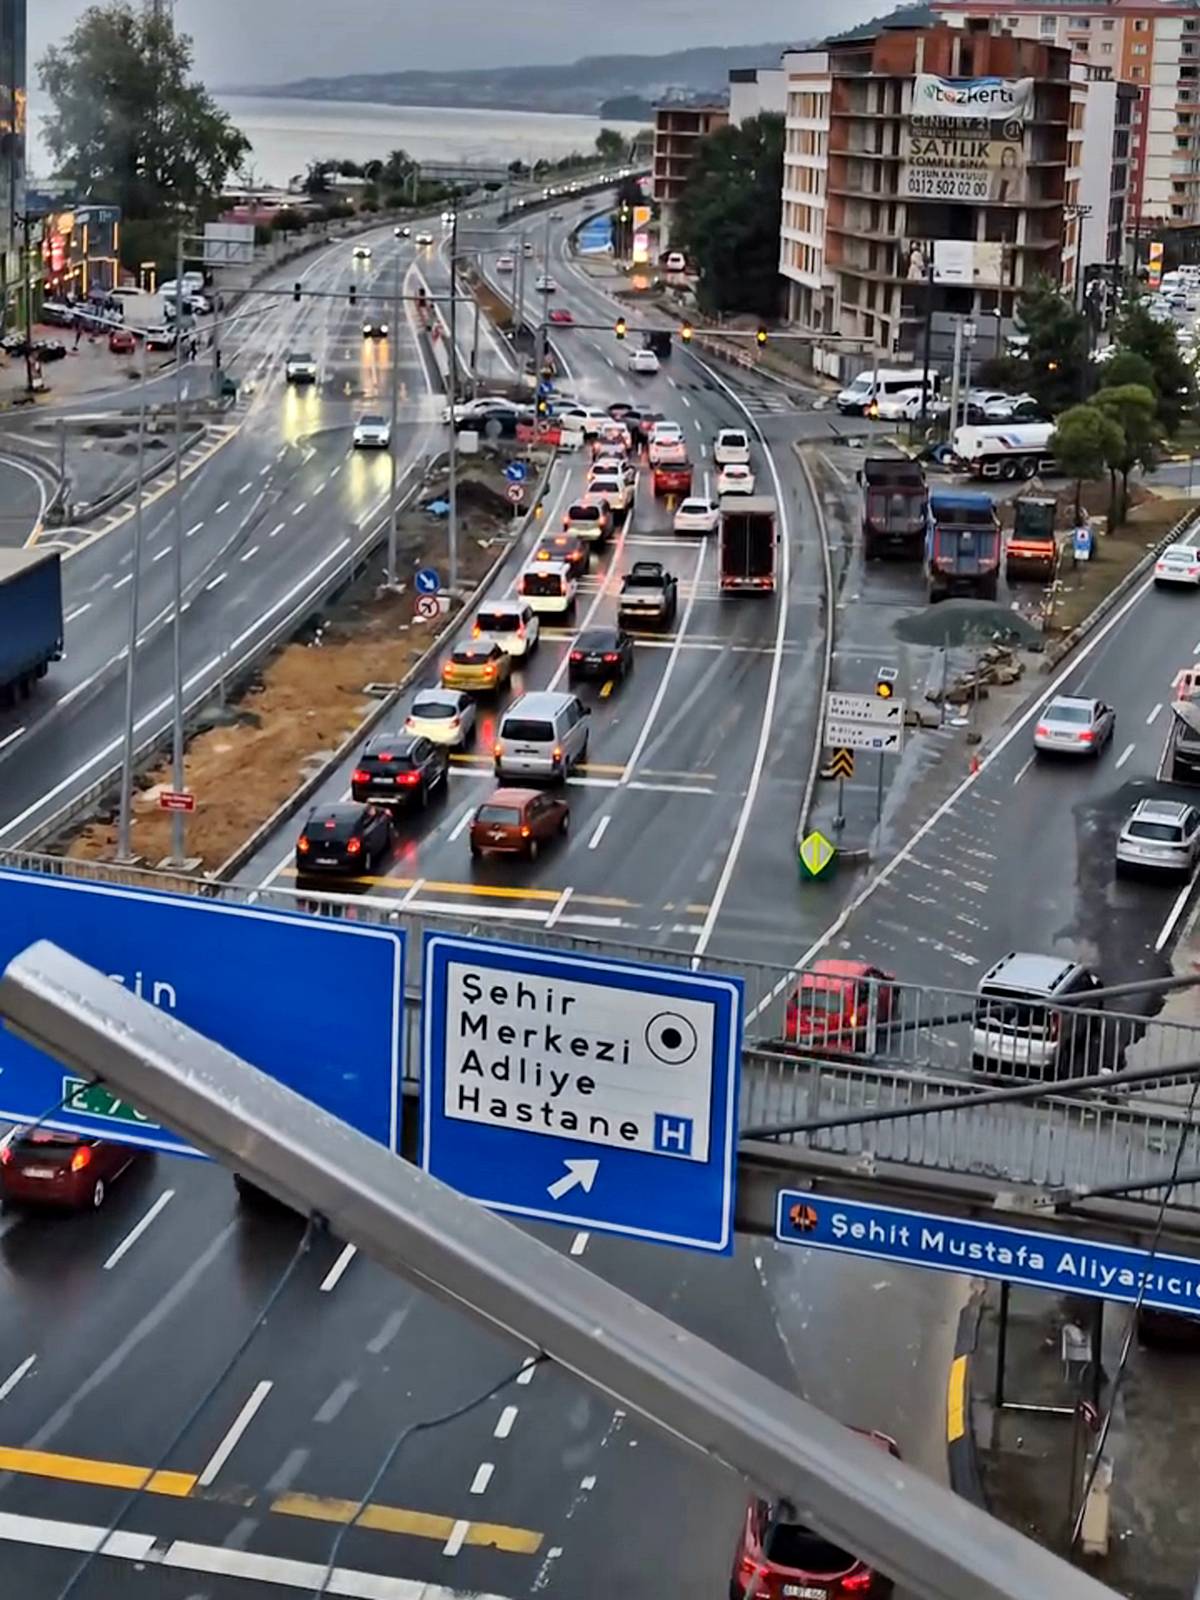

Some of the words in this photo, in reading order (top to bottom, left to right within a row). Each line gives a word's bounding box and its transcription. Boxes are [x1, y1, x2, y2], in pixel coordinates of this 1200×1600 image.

[910, 139, 990, 158] SATILIK
[908, 178, 934, 194] 0312
[936, 180, 956, 195] 502
[957, 181, 971, 196] 02
[973, 182, 987, 197] 00
[462, 973, 576, 1016] Şehir
[460, 1011, 630, 1065] Merkezi
[460, 1049, 596, 1097] Adliye
[458, 1084, 640, 1141] Hastane
[661, 1118, 686, 1151] H
[831, 1213, 909, 1247] Şehit
[921, 1233, 1045, 1270] Mustafa
